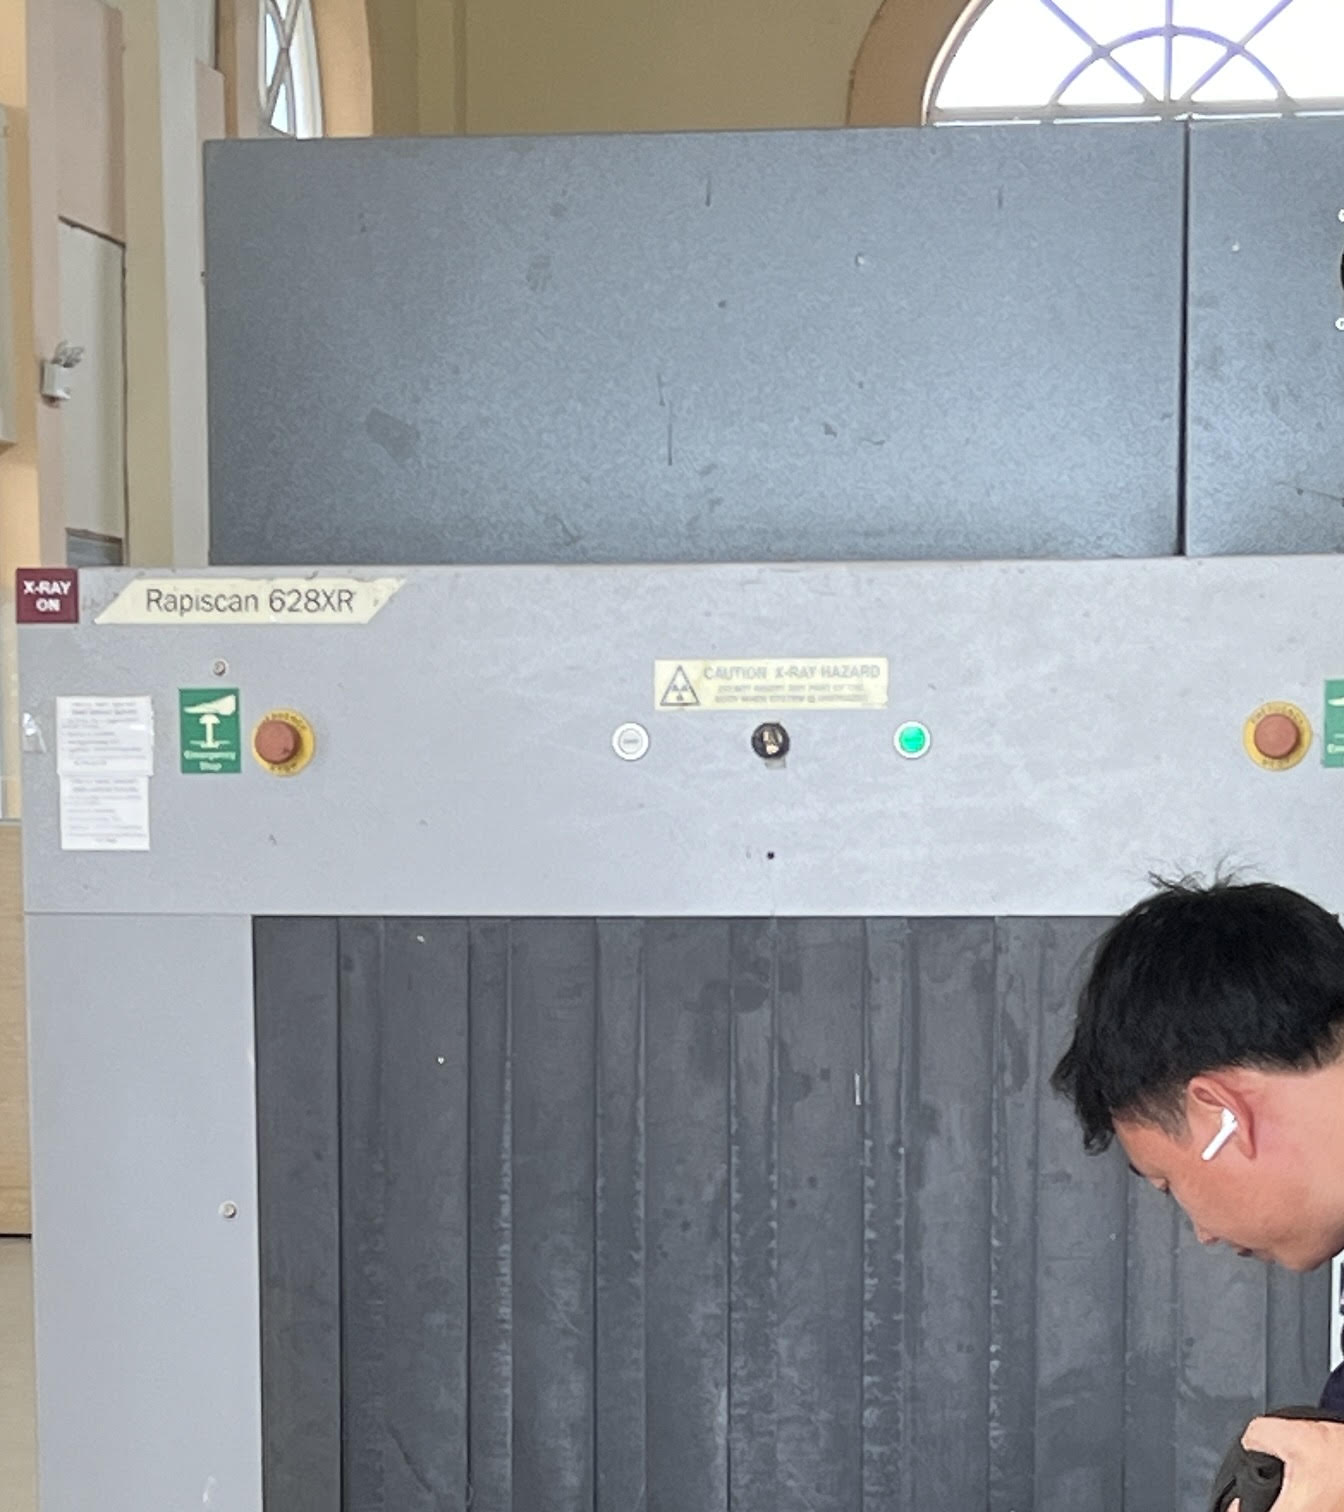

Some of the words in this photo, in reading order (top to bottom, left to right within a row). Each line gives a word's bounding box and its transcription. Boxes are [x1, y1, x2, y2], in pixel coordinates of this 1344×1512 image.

[22, 580, 71, 595] X-RAY
[35, 598, 61, 612] ON
[146, 587, 258, 617] Rapiscan
[268, 587, 355, 614] 628XR
[704, 666, 767, 681] CAUTION
[774, 665, 816, 680] X-RAY
[821, 664, 881, 679] HAZARD
